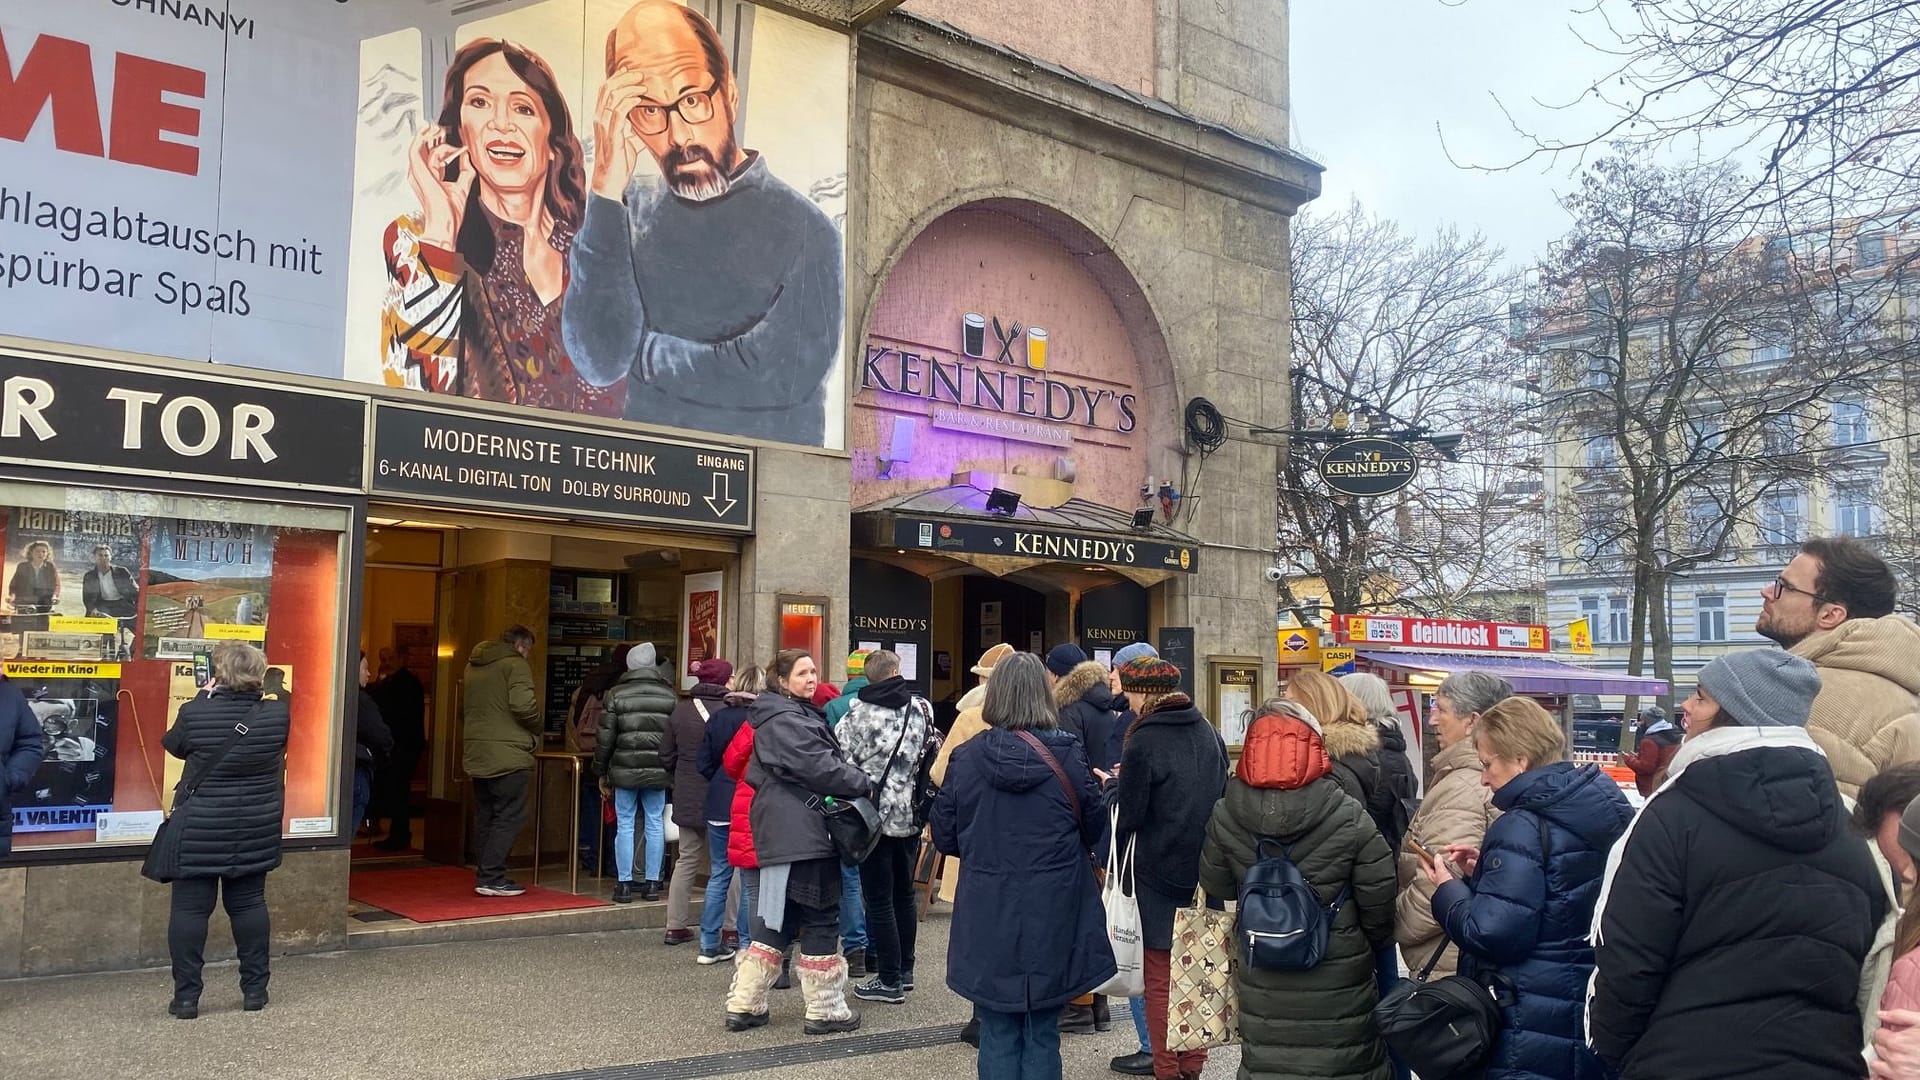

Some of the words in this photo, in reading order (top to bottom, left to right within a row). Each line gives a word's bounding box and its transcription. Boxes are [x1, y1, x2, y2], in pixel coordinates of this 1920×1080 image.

[111, 0, 255, 40] HNANYI
[270, 238, 323, 275] mit
[154, 271, 252, 317] Spaß
[862, 344, 1137, 434] KENNEDY'S
[1, 375, 58, 442] R
[106, 387, 278, 464] TOR
[938, 409, 967, 425] BAR
[969, 416, 981, 428] &
[985, 418, 1073, 442] RESTAURANT
[424, 427, 561, 464] MODERNSTE
[571, 446, 656, 475] TECHNIK
[697, 454, 745, 471] EINGANG
[379, 459, 453, 483] 6-KANAL
[458, 467, 517, 490] DIGITAL
[521, 474, 551, 492] TON
[562, 479, 609, 498] DOLBY
[614, 484, 691, 508] SURROUND
[1327, 462, 1411, 475] KENNEDY'S
[174, 538, 253, 565] MILCH
[1013, 532, 1135, 564] KENNEDY'S
[1412, 621, 1489, 646] deinkiosk
[7, 664, 50, 675] Wieder
[52, 664, 65, 674] im
[67, 665, 98, 675] Kino!
[1326, 652, 1351, 660] CASH
